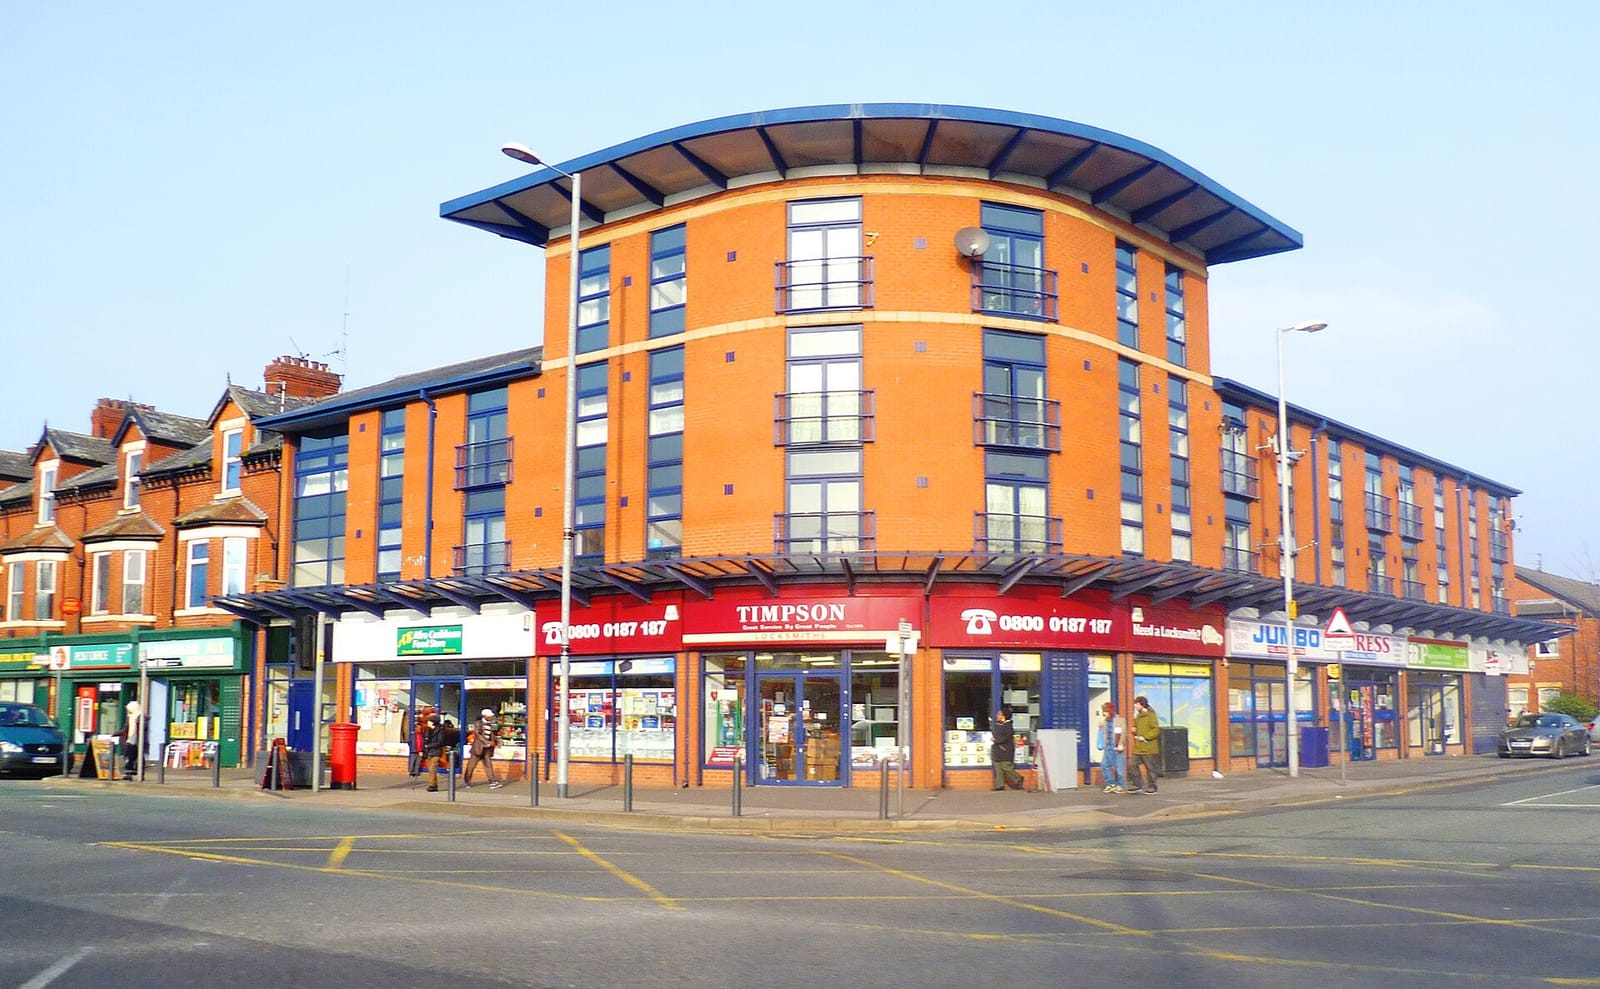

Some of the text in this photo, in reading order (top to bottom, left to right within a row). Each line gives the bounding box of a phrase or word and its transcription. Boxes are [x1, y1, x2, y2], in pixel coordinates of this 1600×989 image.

[736, 604, 846, 622] TIMPSON
[567, 620, 667, 639] 0800 0187 187
[1000, 615, 1113, 634] 0800 0187 187
[1133, 623, 1201, 641] Need a Locksmith?
[754, 632, 826, 640] LOCKSMITHS
[1253, 624, 1320, 648] JUMBO
[1356, 634, 1390, 653] RESS
